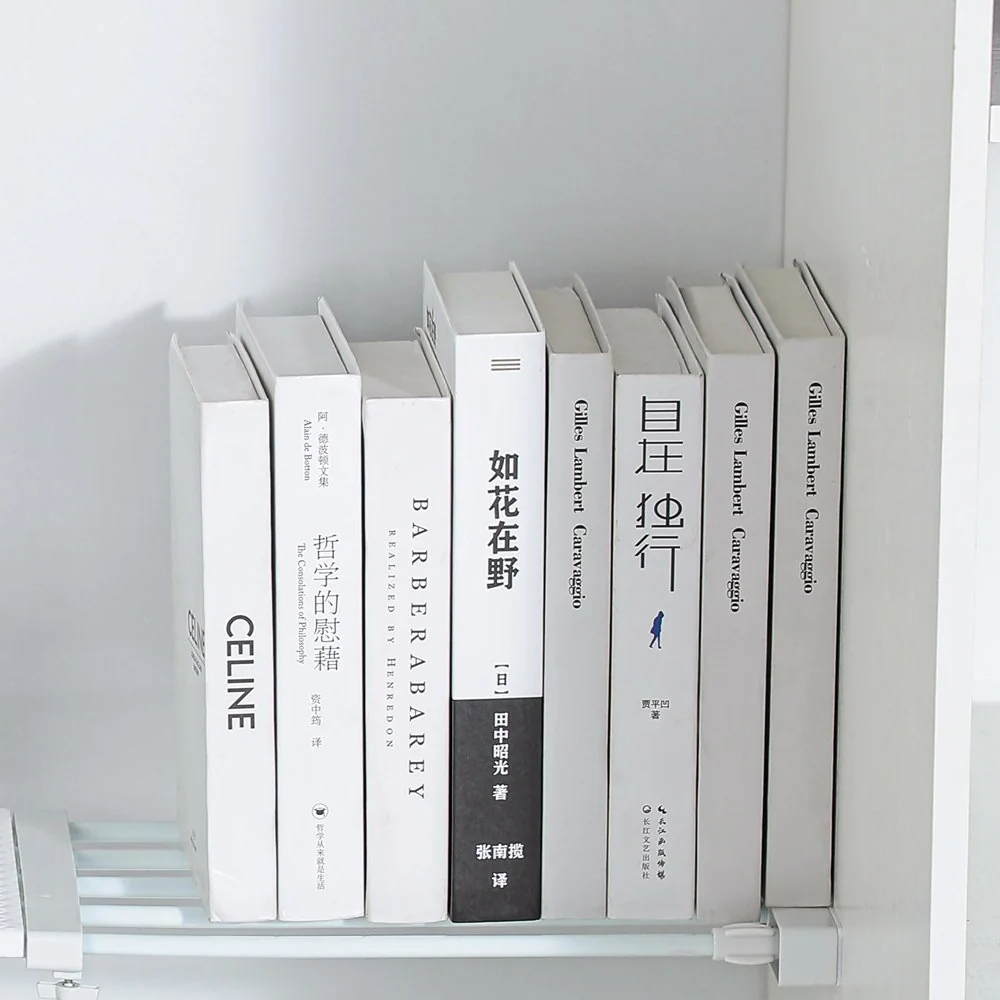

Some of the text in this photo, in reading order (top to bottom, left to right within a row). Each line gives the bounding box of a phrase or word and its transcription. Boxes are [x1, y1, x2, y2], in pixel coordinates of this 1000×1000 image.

[303, 418, 313, 481] Alain de Botton
[800, 382, 823, 594] Gilles Lambert Caravaggio
[486, 449, 520, 590] 如花在野
[568, 399, 589, 609] Gilles Lambert Caravaggio
[726, 401, 749, 613] Gilles Lambert Caravaggio
[295, 542, 307, 664] The Consolations of Philosophy
[313, 534, 341, 672] 哲学的慰藉
[387, 529, 397, 613] REALIZED
[225, 614, 256, 731] CELINE
[387, 625, 395, 644] BY
[408, 497, 429, 799] BARBERABAREY
[641, 699, 670, 709] 贾平凹
[650, 710, 661, 720] 著
[492, 712, 509, 801] 田中昭光 著
[475, 842, 525, 860] 张南揽
[491, 872, 508, 889] 译
[641, 817, 651, 880] 长江文艺出版社
